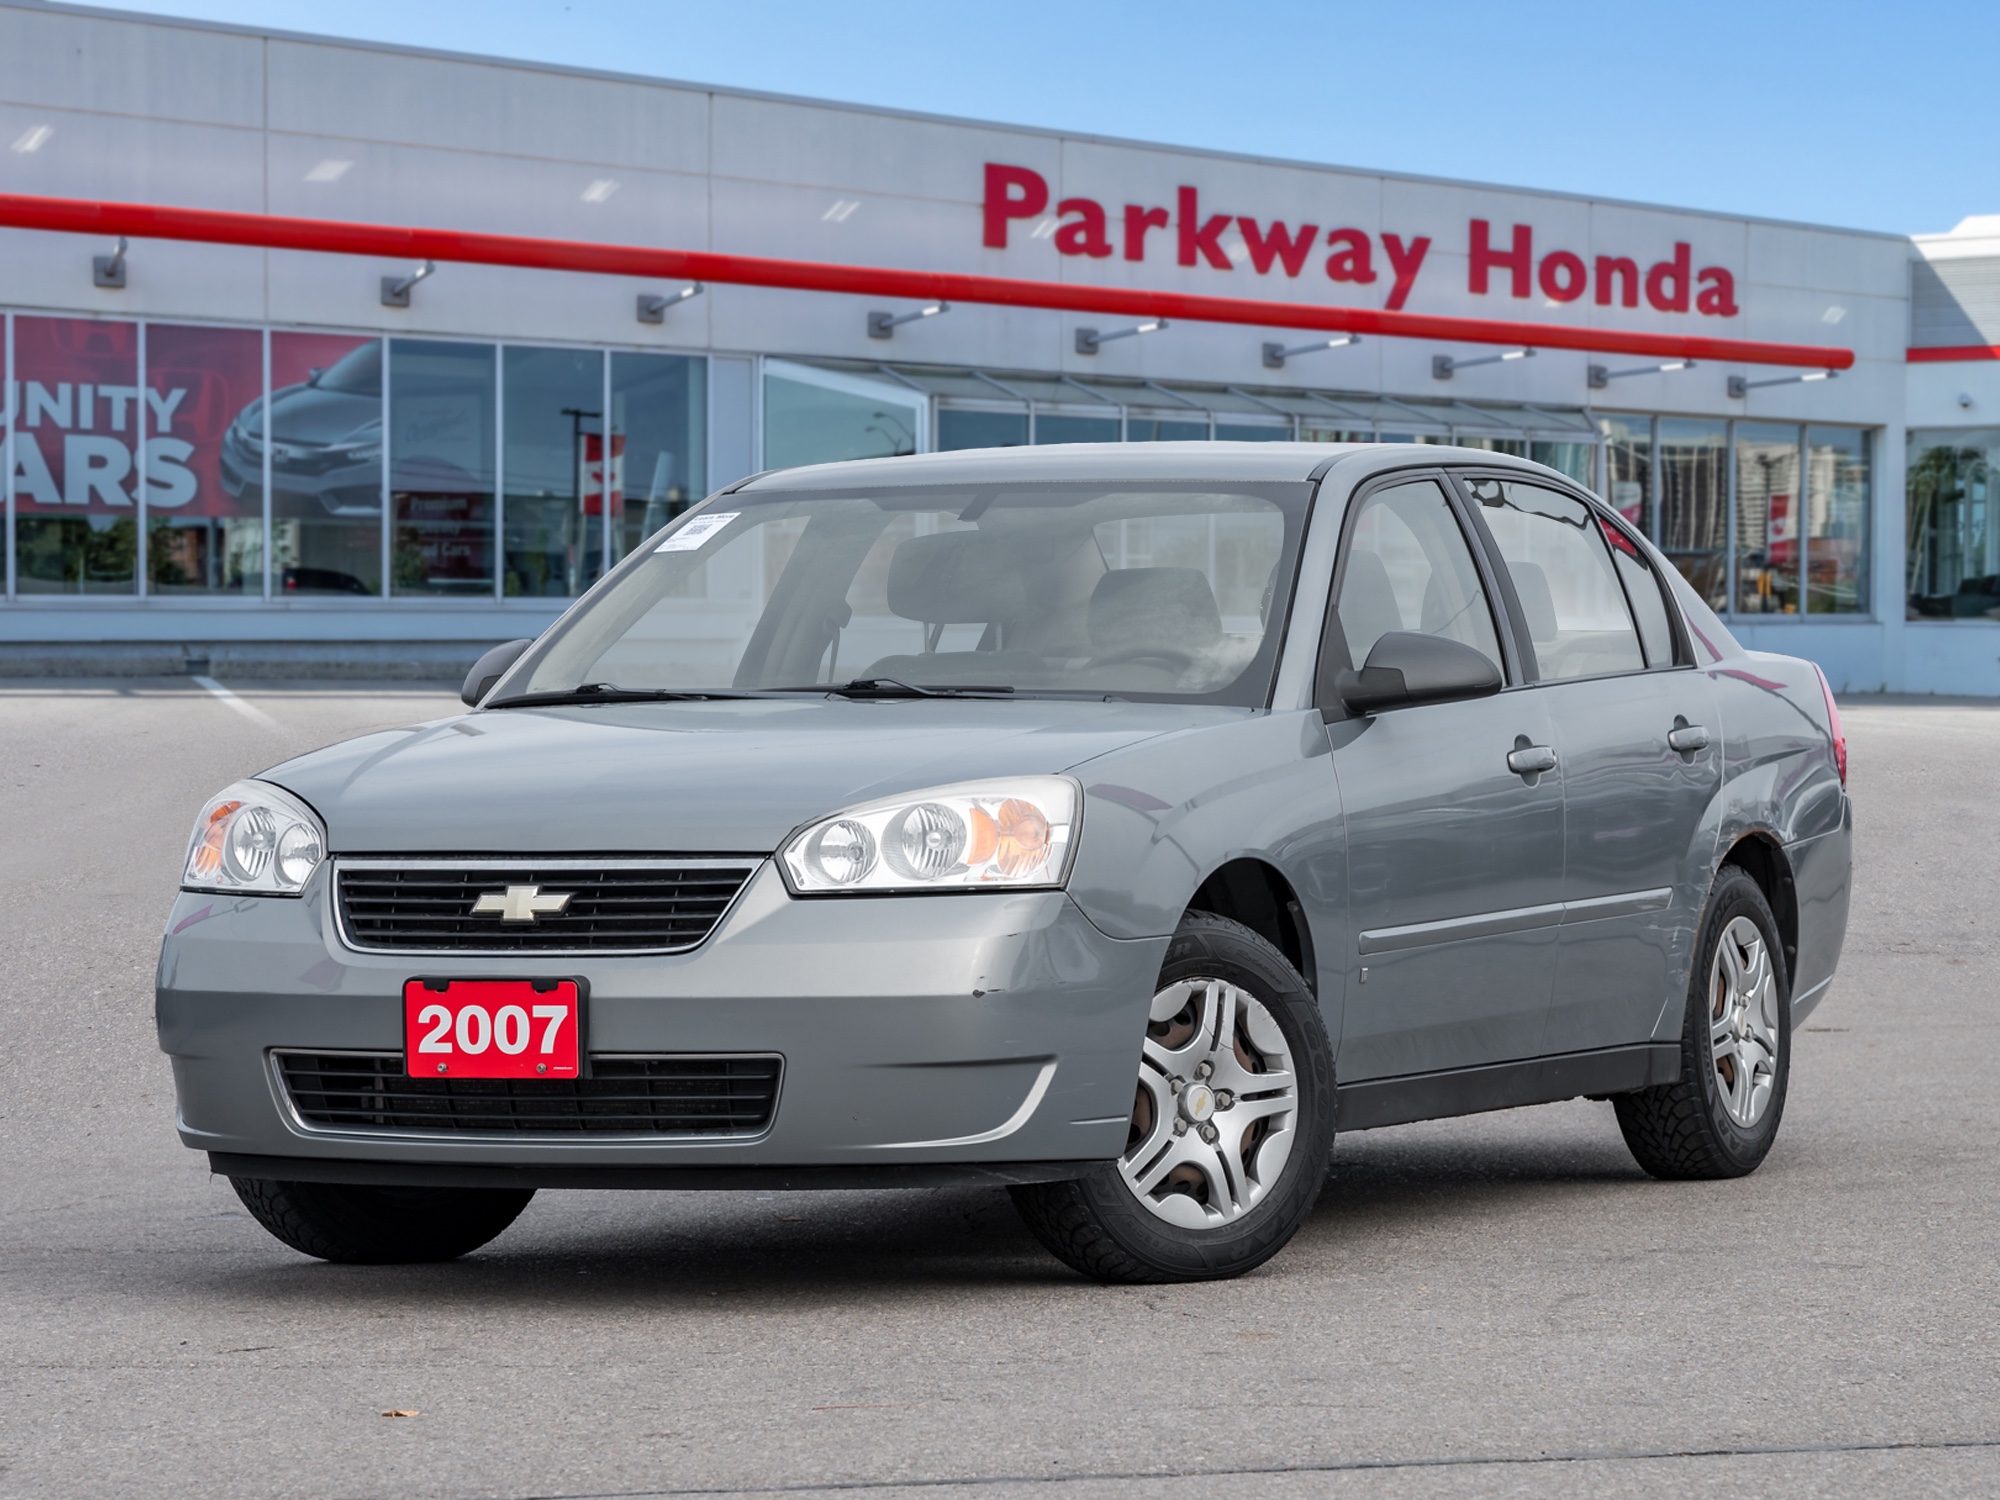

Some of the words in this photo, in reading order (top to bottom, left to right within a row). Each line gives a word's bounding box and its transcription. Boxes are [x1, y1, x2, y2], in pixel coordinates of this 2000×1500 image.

[983, 163, 1432, 311] Parkway
[1468, 218, 1739, 317] Honda
[0, 432, 198, 508] ARS
[418, 1004, 568, 1055] 2007
